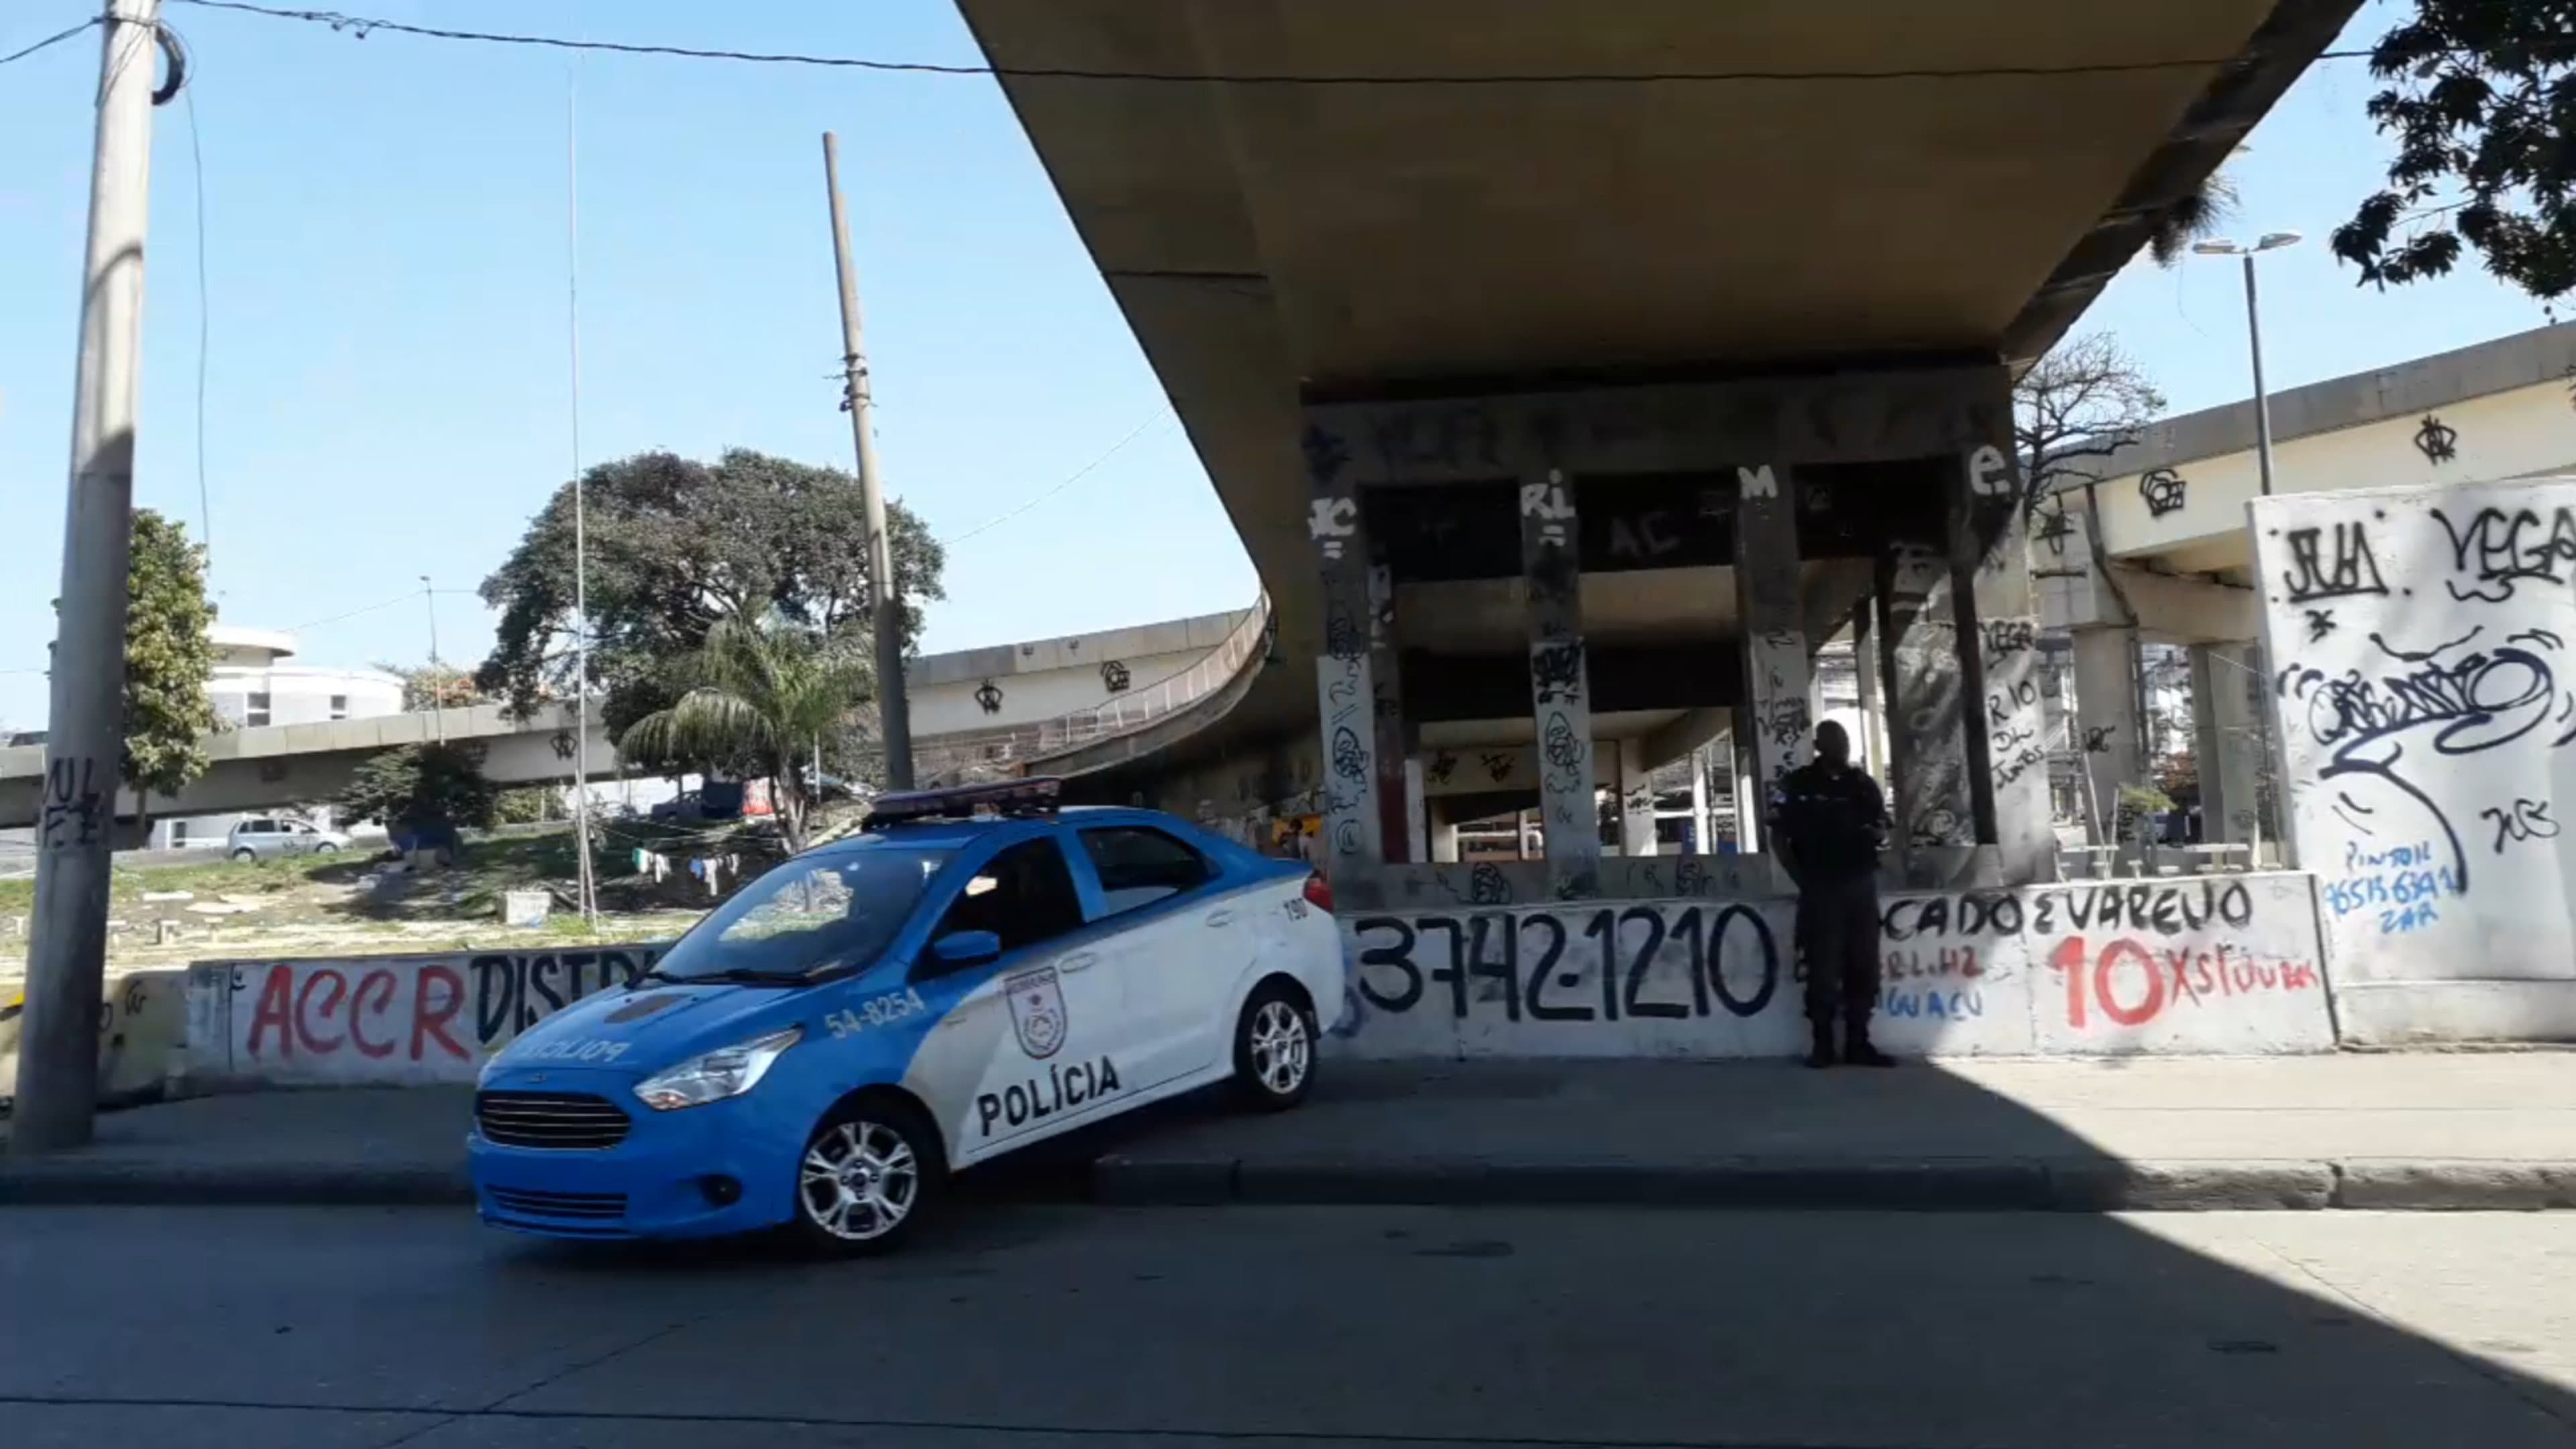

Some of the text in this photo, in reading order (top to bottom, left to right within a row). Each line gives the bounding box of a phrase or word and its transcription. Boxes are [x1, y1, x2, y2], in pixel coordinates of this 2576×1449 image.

[1282, 898, 1309, 922] 190
[1878, 894, 2023, 942] CADO
[247, 949, 655, 1060] ACCR DIST
[824, 987, 925, 1039] 54-8254
[979, 1055, 1120, 1136] POLÍCIA
